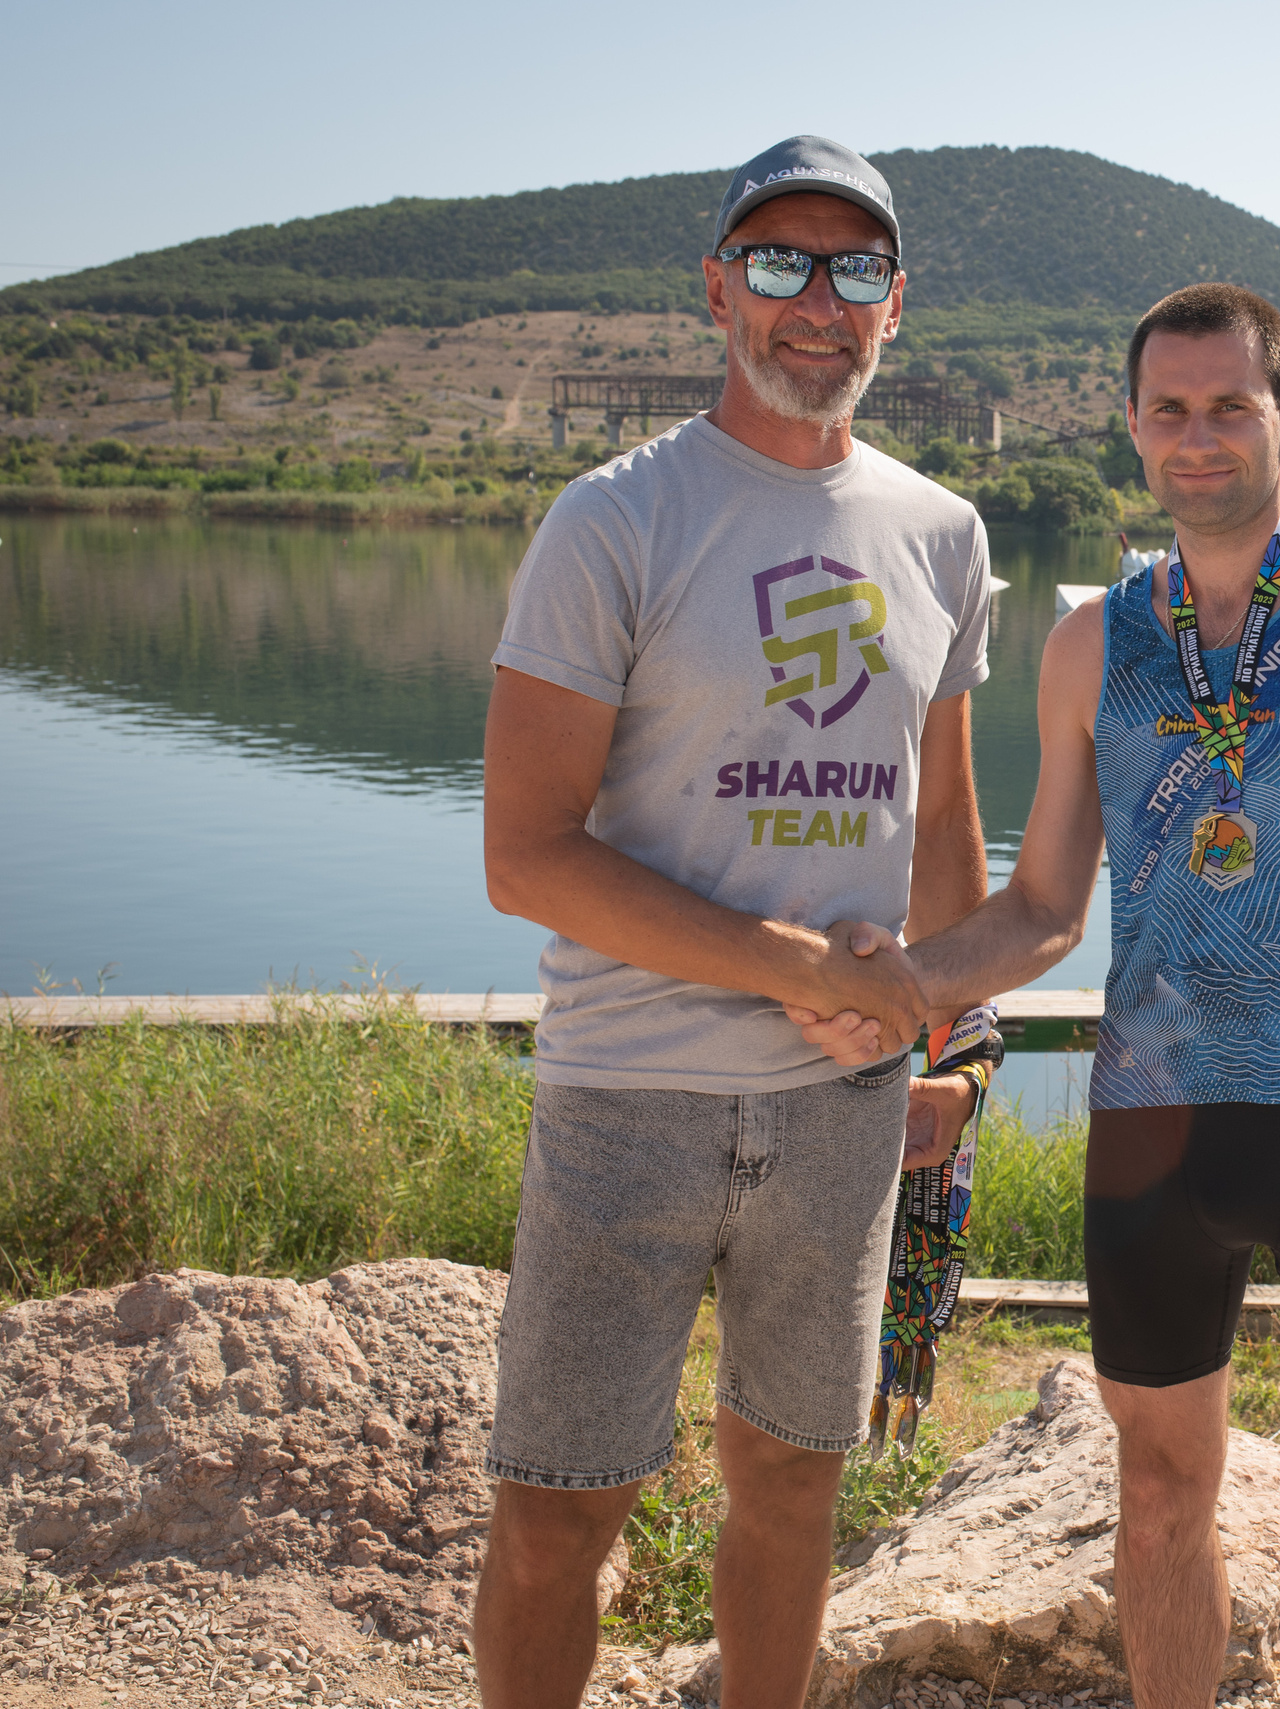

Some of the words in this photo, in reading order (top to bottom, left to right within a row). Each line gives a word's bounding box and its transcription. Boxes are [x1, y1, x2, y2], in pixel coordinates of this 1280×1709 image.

[1252, 594, 1274, 605] 2023
[1176, 617, 1196, 630] 2023
[1244, 605, 1270, 665] ТРИАТЛОНУ
[1185, 628, 1205, 681] ТРИАТЛОНУ
[1234, 645, 1246, 682] ЧЕМПИОНАТ
[1241, 603, 1259, 645] СЕВАСТОПОЛЯ
[1184, 666, 1200, 701] ЧЕМПИОНАТ
[1197, 681, 1211, 698] ПО
[1240, 667, 1253, 683] ПО
[715, 760, 899, 801] SHARUN
[1147, 746, 1207, 814] TRAIL
[747, 809, 868, 848] TEAM
[1130, 850, 1159, 894] 19.10.19
[952, 1032, 981, 1049] TEAM
[914, 1168, 922, 1199] ТРИАТ
[930, 1167, 940, 1206] ТРИАТЛ
[913, 1201, 922, 1216] ПО
[930, 1209, 939, 1223] ПО
[896, 1263, 906, 1277] ПО
[951, 1250, 965, 1259] 2023
[939, 1262, 963, 1319] ТРИАТЛОНУ
